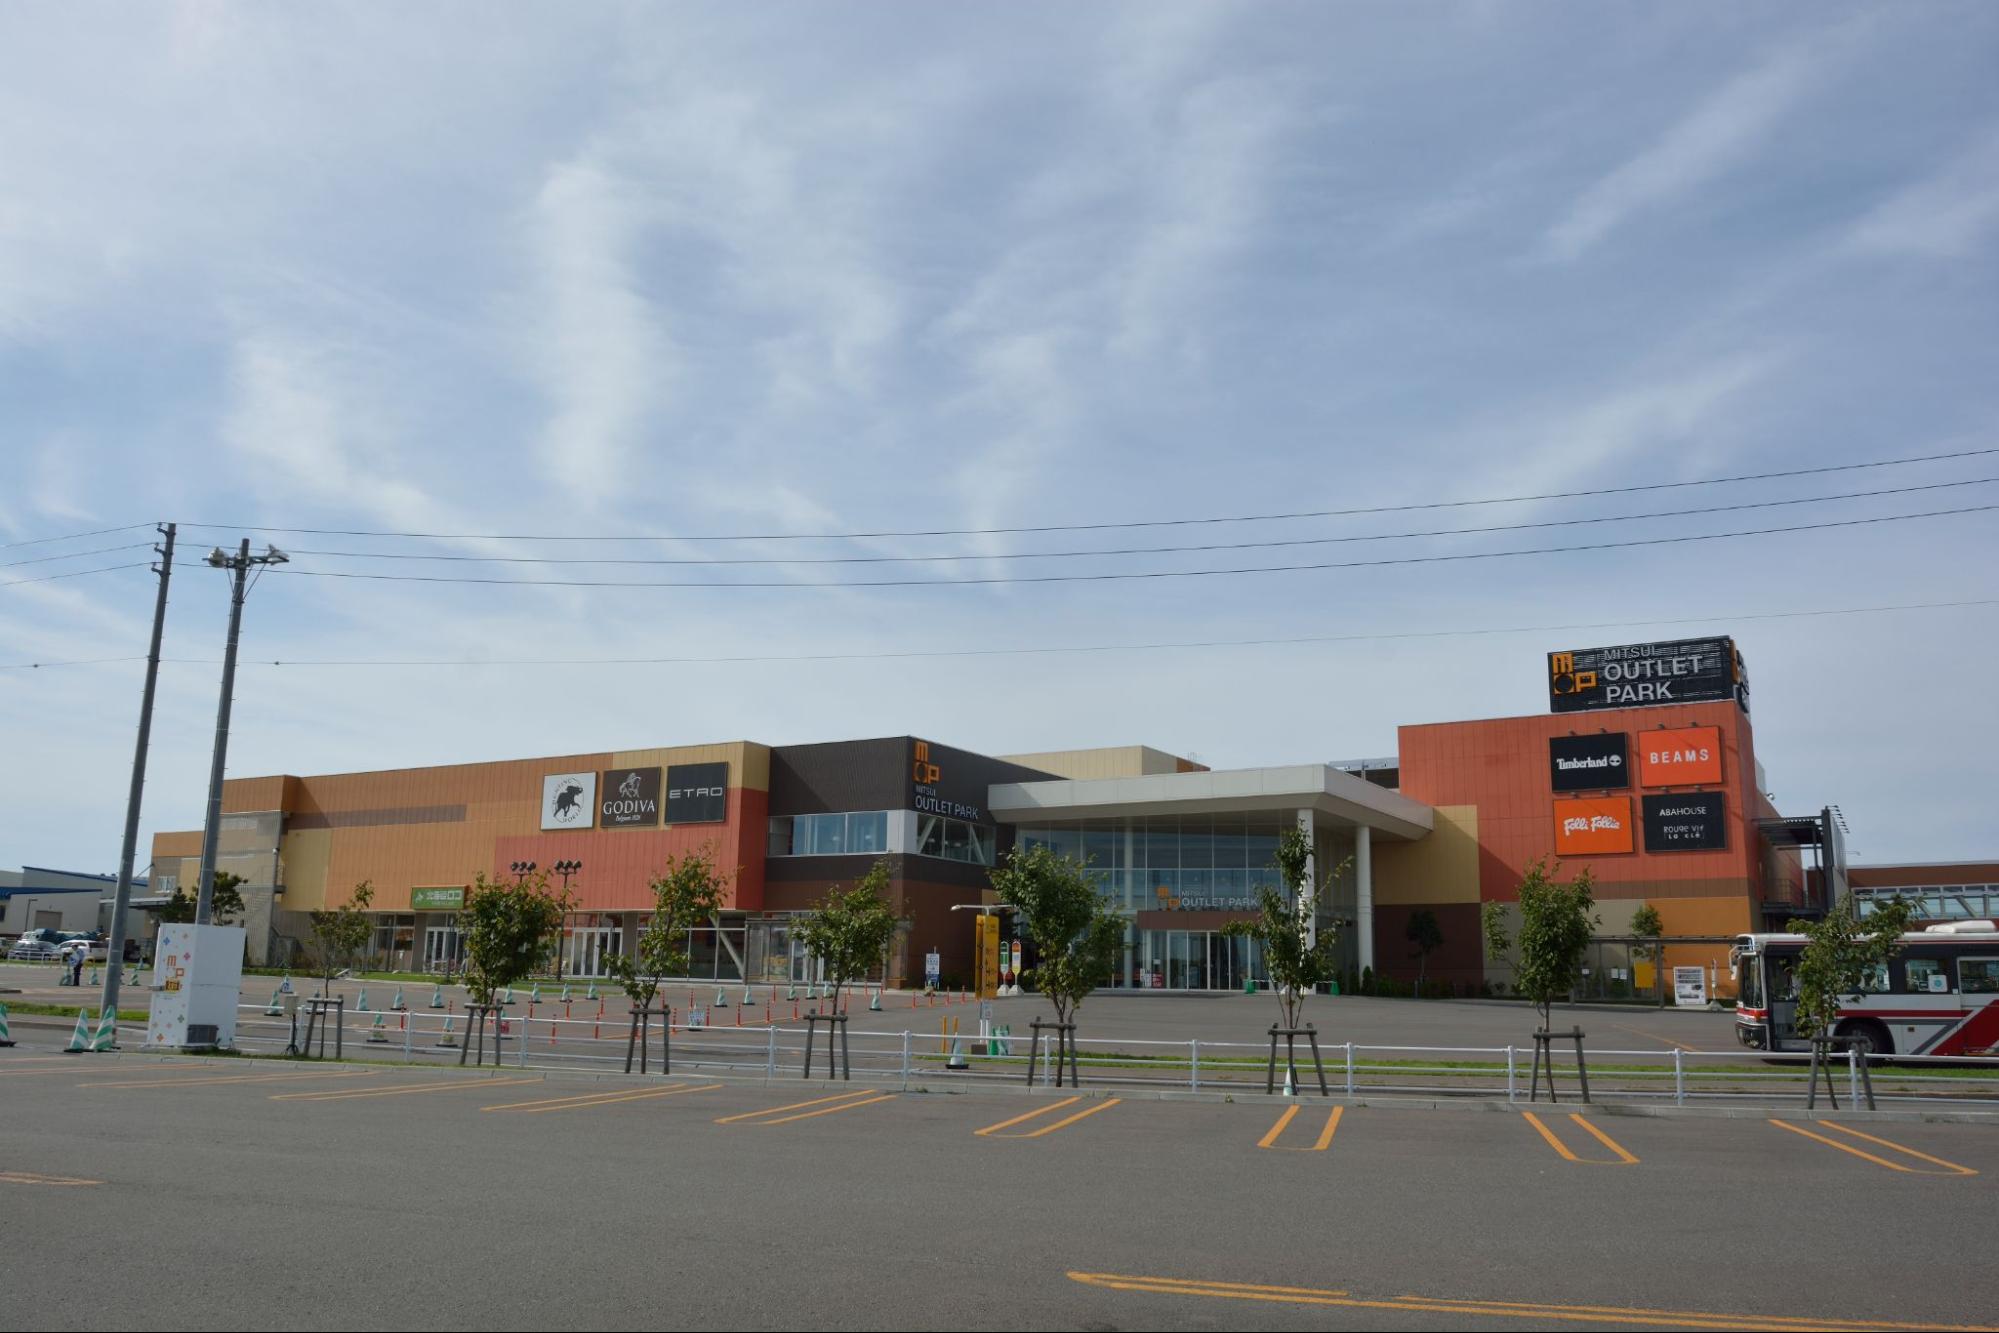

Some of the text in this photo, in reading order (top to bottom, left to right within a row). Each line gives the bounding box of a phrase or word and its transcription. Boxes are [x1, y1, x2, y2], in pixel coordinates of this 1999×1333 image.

[1603, 645, 1656, 661] MITSUI
[1604, 655, 1703, 681] OUTLET
[1606, 681, 1674, 703] PARK
[1556, 756, 1608, 769] Timberland
[1650, 748, 1709, 764] BEAMS
[669, 787, 723, 799] ETRO
[603, 800, 656, 815] GODIVA
[915, 795, 978, 819] OUTLET PARK
[1659, 806, 1707, 816] ABAHOUSE
[1563, 815, 1620, 836] Folli Follie
[1182, 897, 1224, 907] OUTLET
[1228, 897, 1258, 907] PARK
